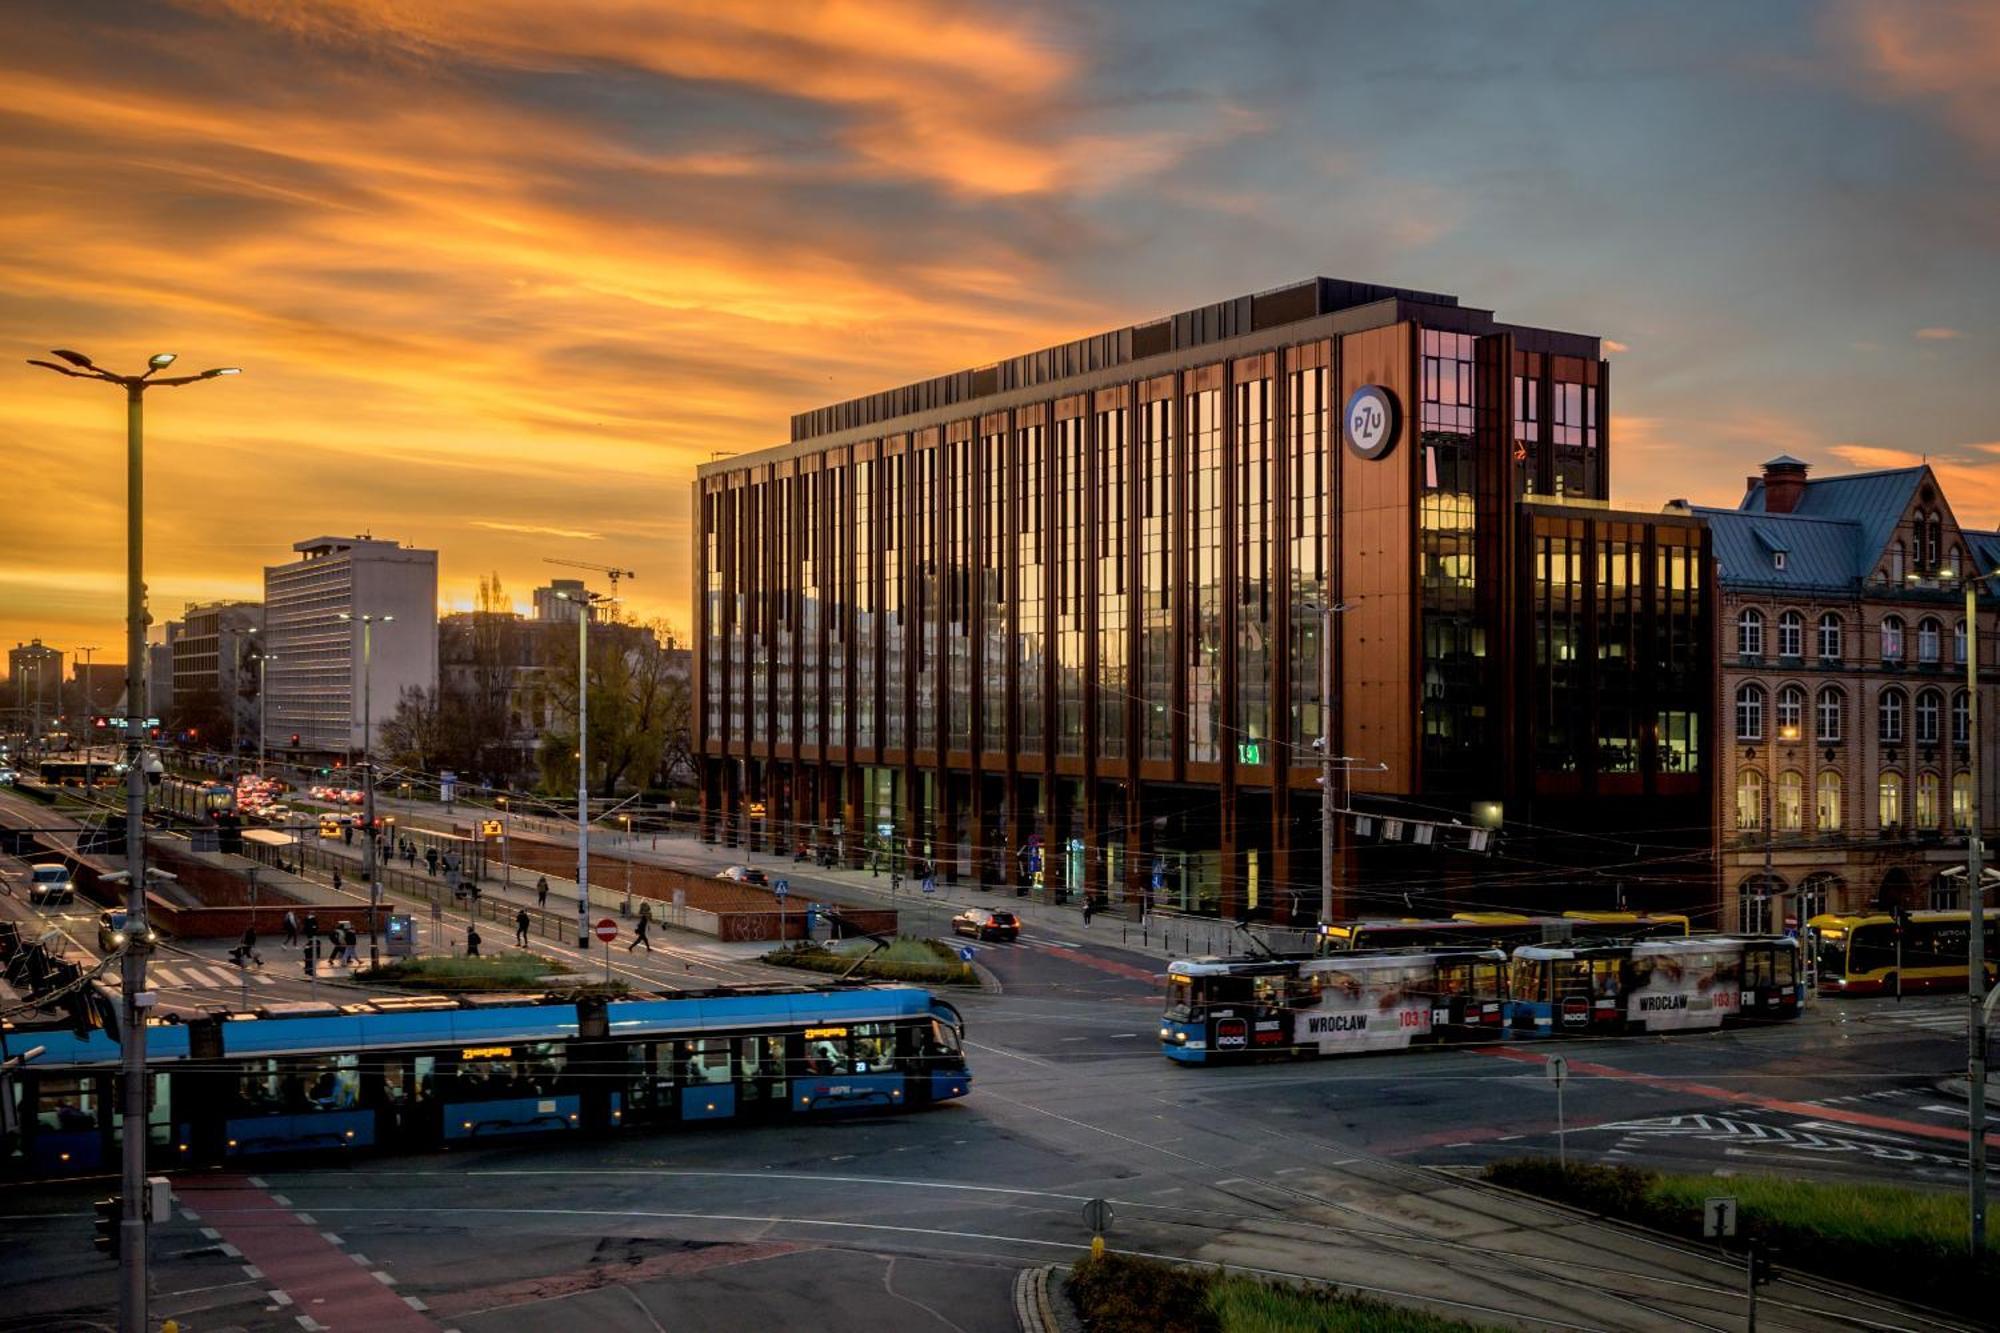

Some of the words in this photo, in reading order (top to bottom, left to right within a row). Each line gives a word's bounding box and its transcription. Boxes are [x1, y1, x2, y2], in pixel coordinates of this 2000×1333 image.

[1353, 406, 1382, 438] PZU
[1640, 994, 1688, 1011] WROCŁAW
[1308, 1014, 1367, 1033] WROCŁAW
[1433, 1009, 1449, 1025] FM
